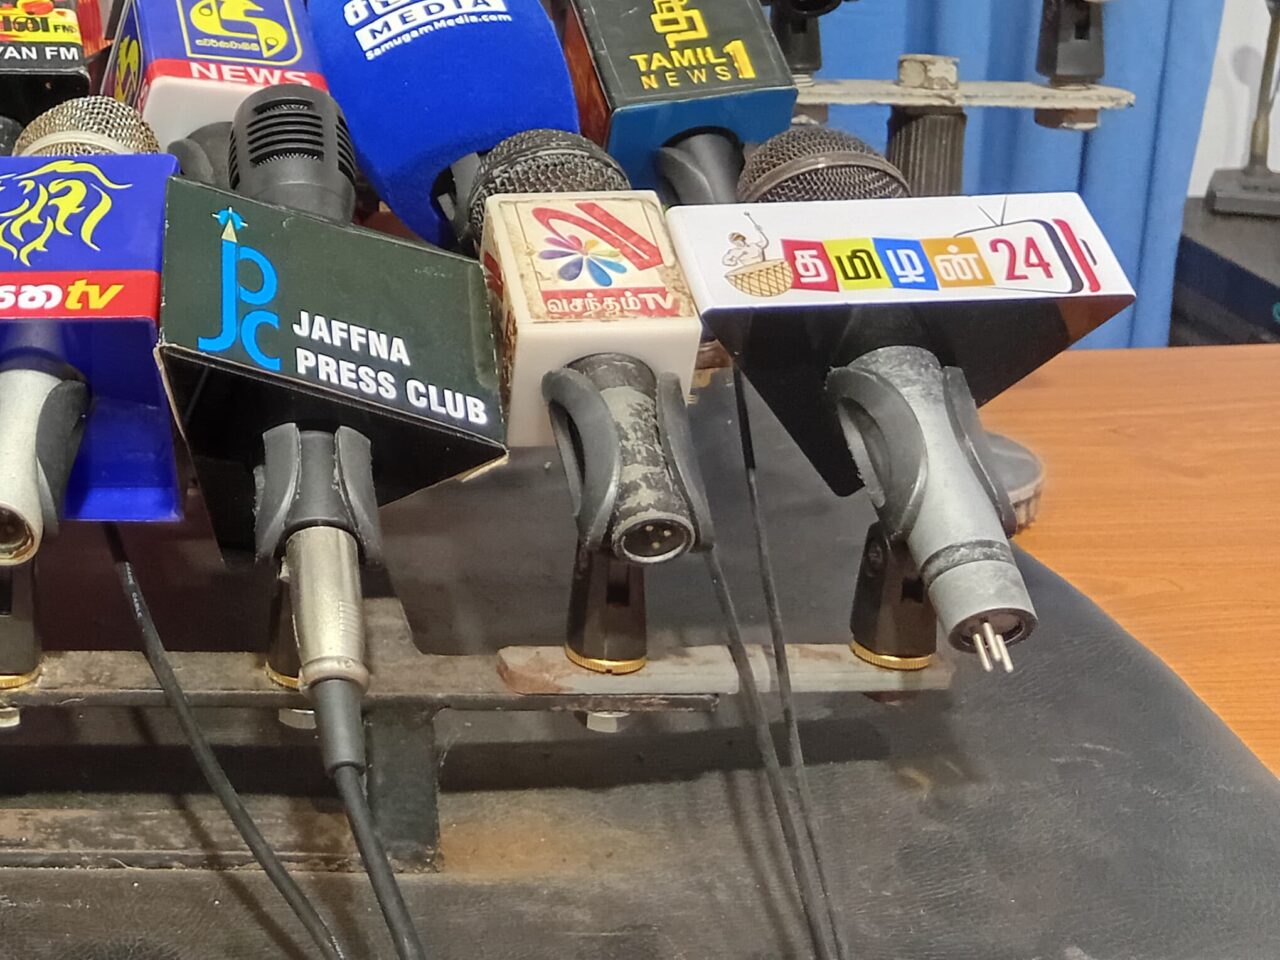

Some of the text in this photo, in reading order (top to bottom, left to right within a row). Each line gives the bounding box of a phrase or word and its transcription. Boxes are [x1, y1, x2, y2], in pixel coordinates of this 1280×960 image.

[365, 13, 512, 61] SamugamMedia.com
[46, 46, 80, 61] FM
[629, 45, 727, 72] TAMIL
[190, 61, 307, 87] NEWS
[640, 67, 732, 90] NEWS
[791, 236, 1053, 288] தமிழன் 24
[639, 292, 675, 311] TV
[292, 310, 411, 367] JAFFNA
[295, 347, 489, 426] PRESS CLUB
